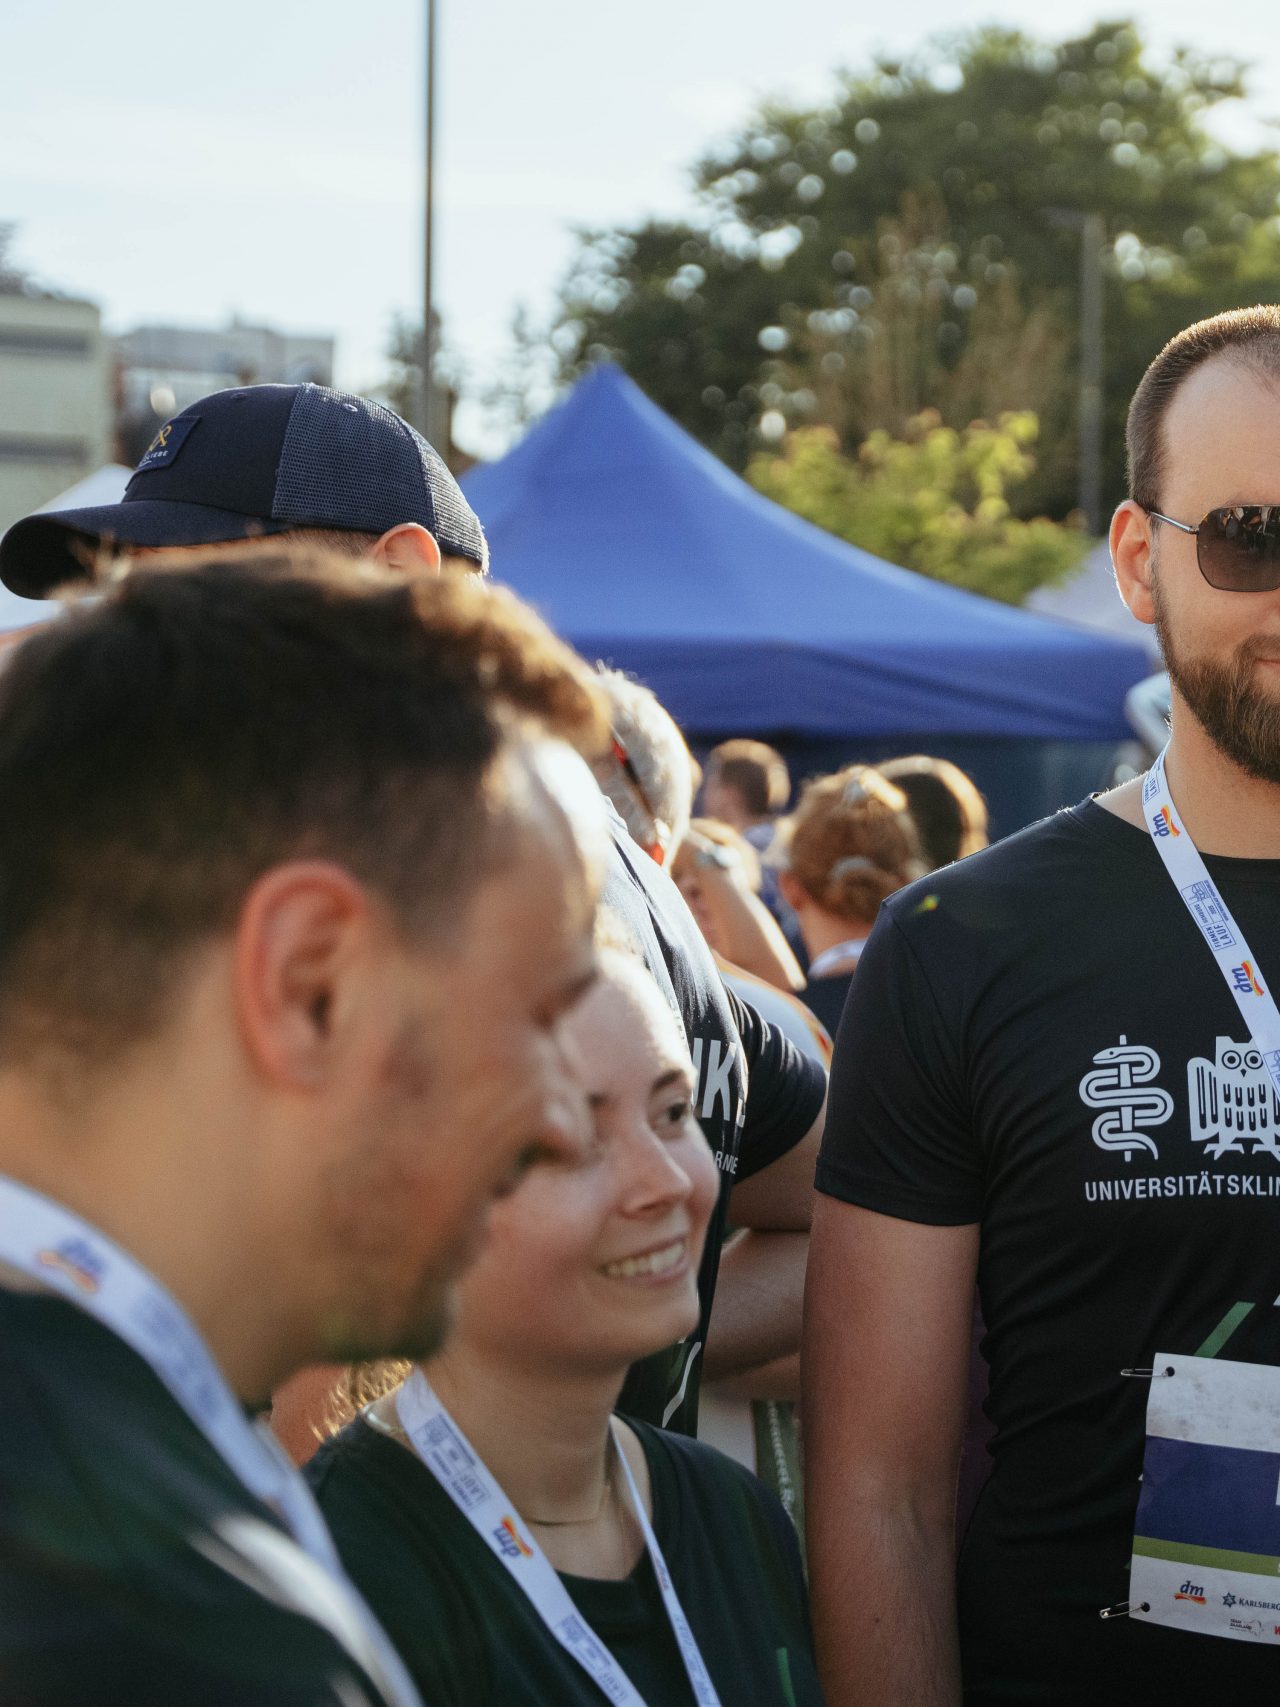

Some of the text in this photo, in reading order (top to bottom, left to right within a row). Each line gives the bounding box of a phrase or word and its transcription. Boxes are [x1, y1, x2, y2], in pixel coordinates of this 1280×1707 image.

[1152, 813, 1170, 837] dm
[1206, 926, 1221, 948] FIRMEN
[1213, 925, 1232, 946] LAUF
[1231, 967, 1253, 993] dm
[1180, 1580, 1204, 1596] dm
